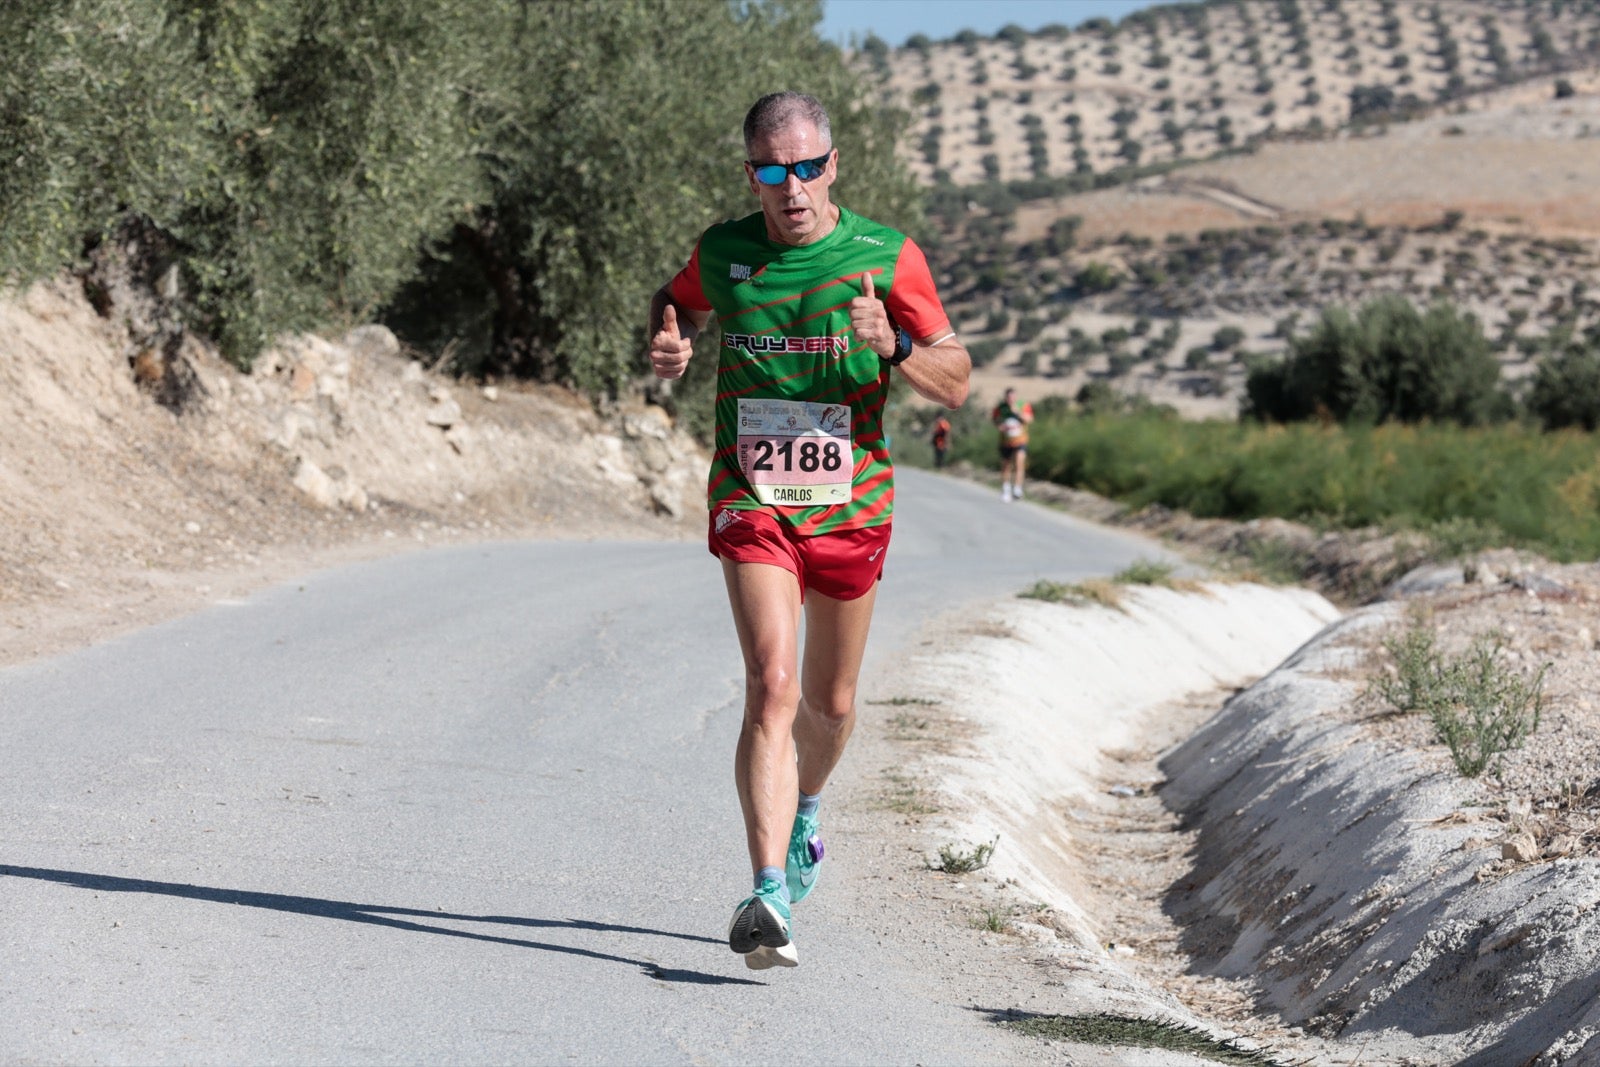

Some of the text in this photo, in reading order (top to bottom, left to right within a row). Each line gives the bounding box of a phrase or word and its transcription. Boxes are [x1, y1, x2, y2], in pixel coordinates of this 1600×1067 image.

[724, 332, 849, 359] GRUYSERV
[752, 440, 842, 473] 2188
[773, 488, 813, 502] CARLOS
